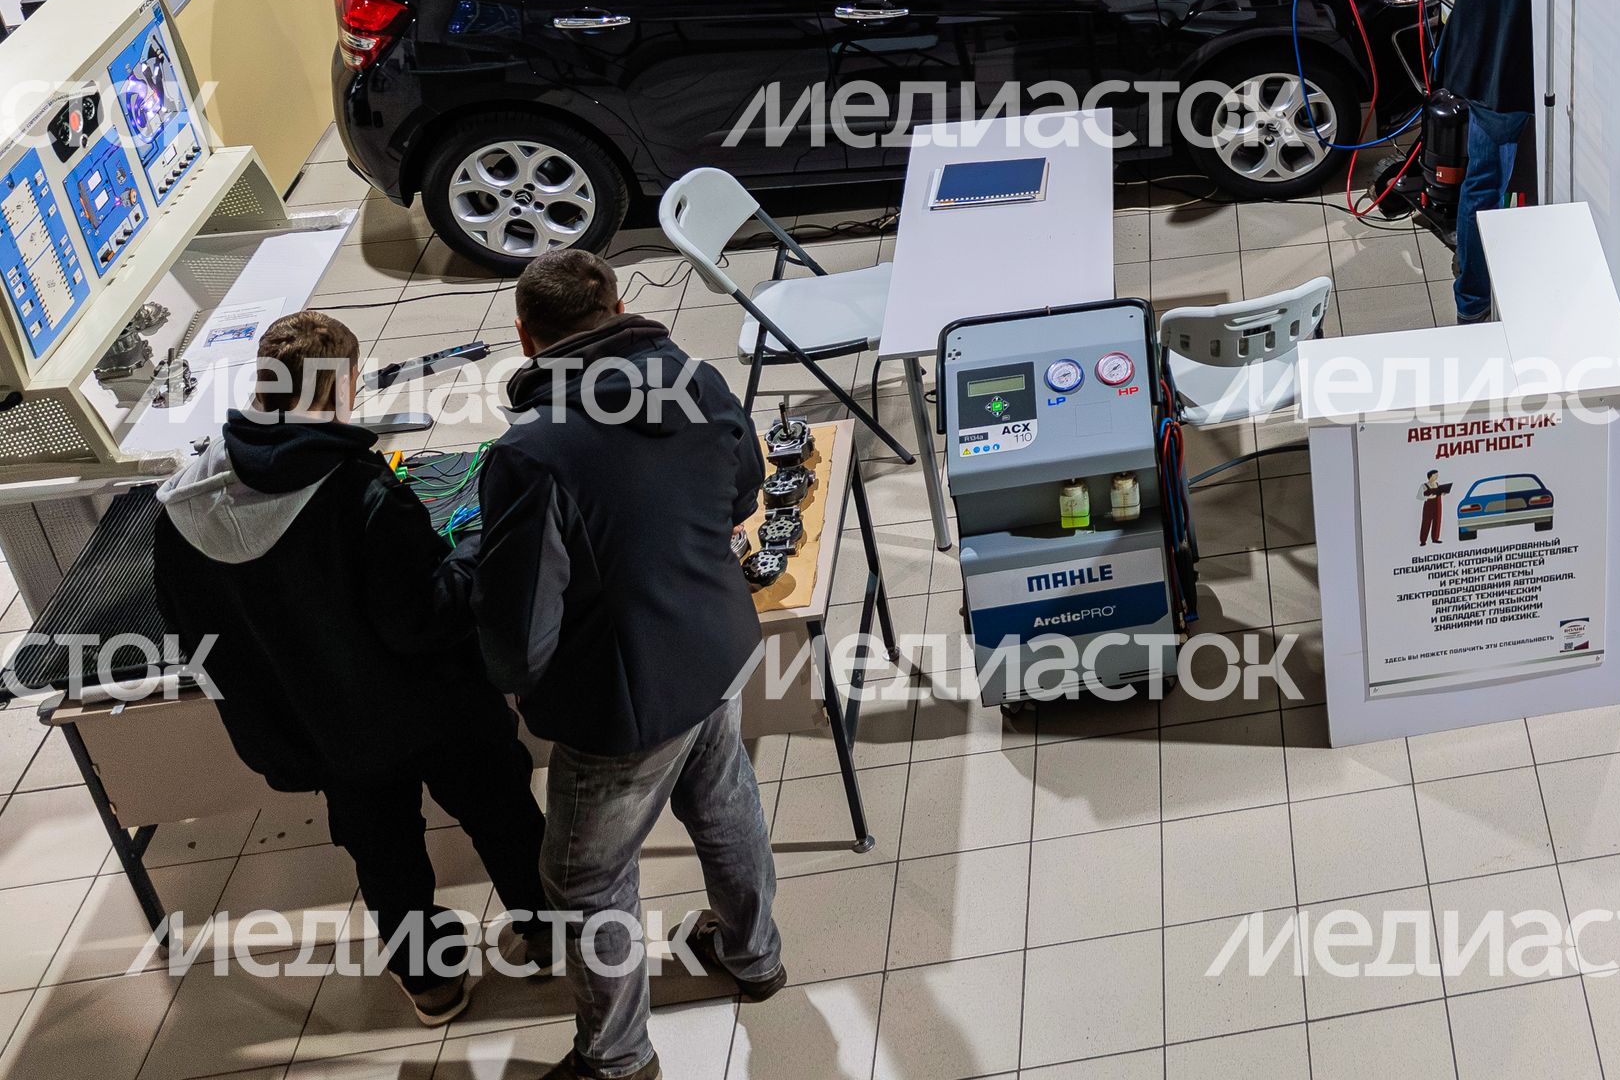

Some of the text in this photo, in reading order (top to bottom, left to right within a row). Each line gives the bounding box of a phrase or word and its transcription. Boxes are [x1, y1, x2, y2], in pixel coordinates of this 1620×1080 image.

[1047, 396, 1066, 406] LP
[1118, 386, 1139, 397] HP
[1002, 423, 1031, 436] ACX
[1015, 432, 1033, 444] 110
[1408, 413, 1561, 443] АВТОЭЛЕКТРИК-
[1436, 433, 1535, 460] ДИАГНОСТ
[1394, 546, 1579, 576] СПЕЦИАЛИСТ, КОТОРЫЙ ОСУЩЕСТВЛЯЕТ
[1412, 537, 1560, 564] ВЫСОКОКВАЛИФИЦИРОВАННЫЙ
[1027, 564, 1113, 592] MAHLE
[1428, 558, 1545, 580] ПОИСК НЕИСПРАВНОСТЕЙ
[1440, 569, 1533, 587] И РЕМОНТ СИСТЕМЫ
[1397, 573, 1576, 602] ЭЛЕКТРООБОРУДОВАНИЯ АВТОМОБИЛЯ.
[1432, 585, 1541, 606] ВЛАДЕЕТ ТЕХНИЧЕСКИМ
[1431, 602, 1543, 624] И ОБЛАДАЕТ ГЛУБОКИМИ
[1436, 595, 1538, 614] АНГЛИЙСКИМ ЯЗЫКОМ
[1434, 611, 1540, 632] ЗНАНИЯМИ ПО ФИЗИКЕ.
[1385, 656, 1406, 664] ЗДЕСЬ
[1420, 650, 1448, 659] МОЖЕТЕ
[1449, 645, 1484, 654] ПОЛУЧИТЬ
[1499, 635, 1554, 648] СПЕЦИАЛЬНОСТЬ
